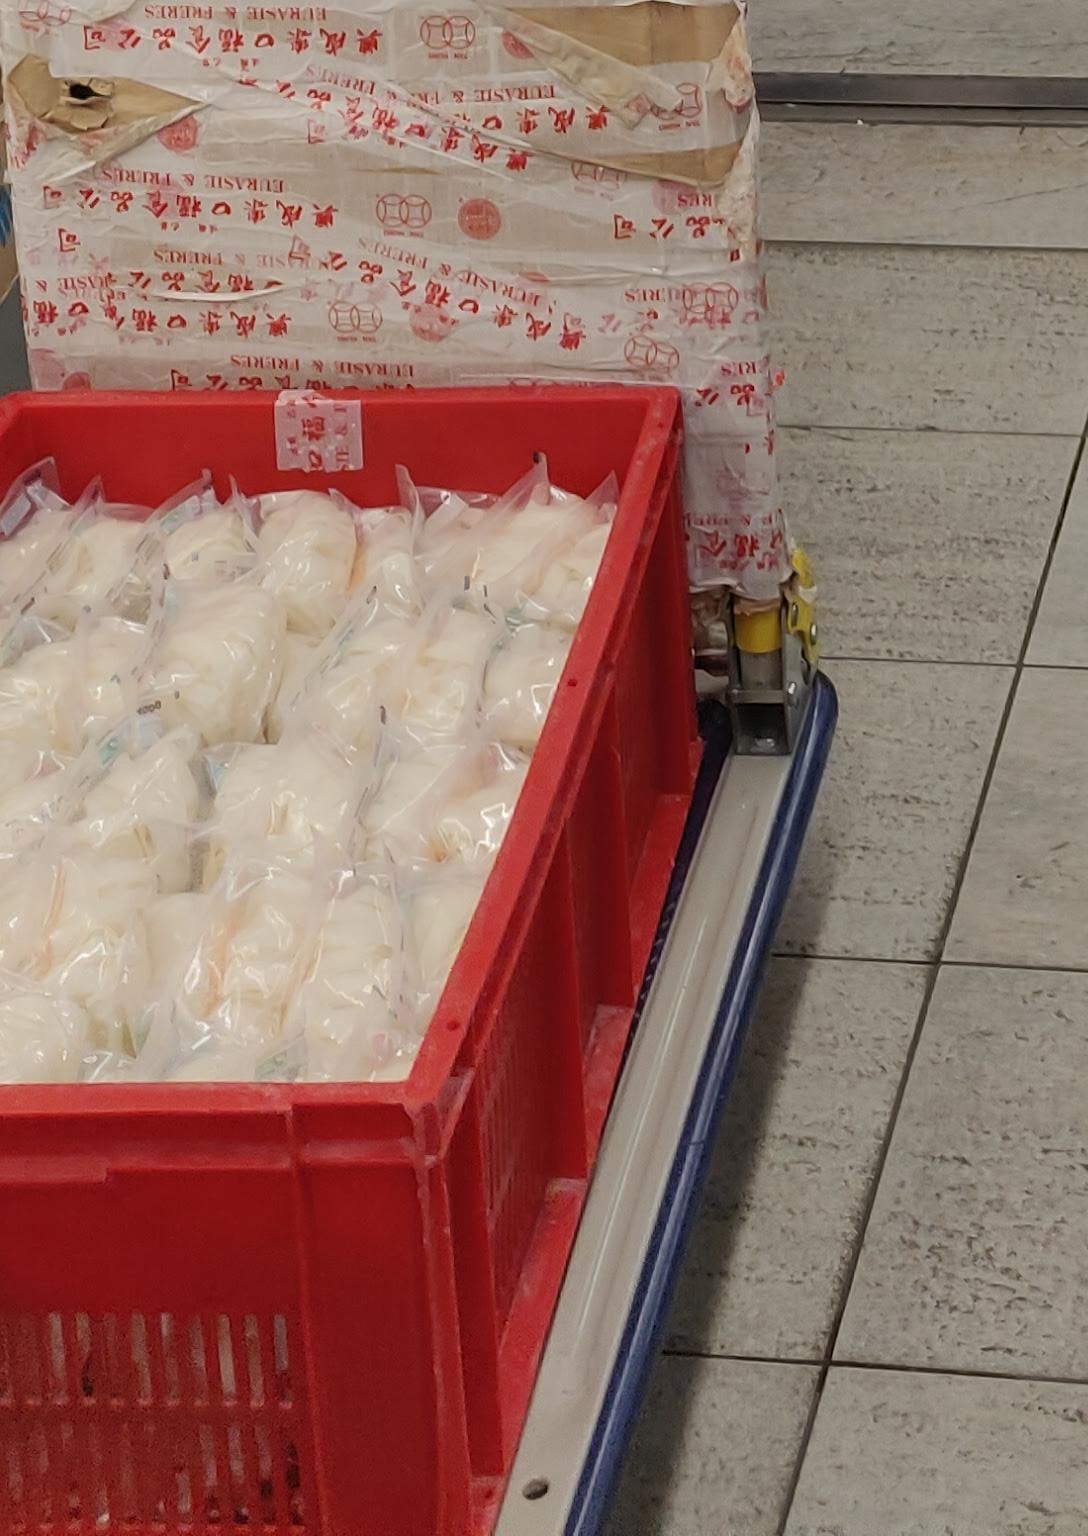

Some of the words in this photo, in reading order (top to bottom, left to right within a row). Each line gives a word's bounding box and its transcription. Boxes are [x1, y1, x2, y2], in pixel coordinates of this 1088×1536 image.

[144, 4, 214, 20] FRERES
[224, 6, 237, 19] &
[247, 5, 328, 22] EURASIE
[452, 89, 465, 103] &
[474, 84, 556, 101] EURASIE
[102, 168, 174, 187] FRERES
[183, 172, 196, 186] &
[205, 174, 285, 193] EURASIE
[153, 249, 224, 266] FRERES
[359, 236, 429, 269] FRERES
[230, 354, 300, 371] FRERES
[336, 359, 415, 377] EURASIE
